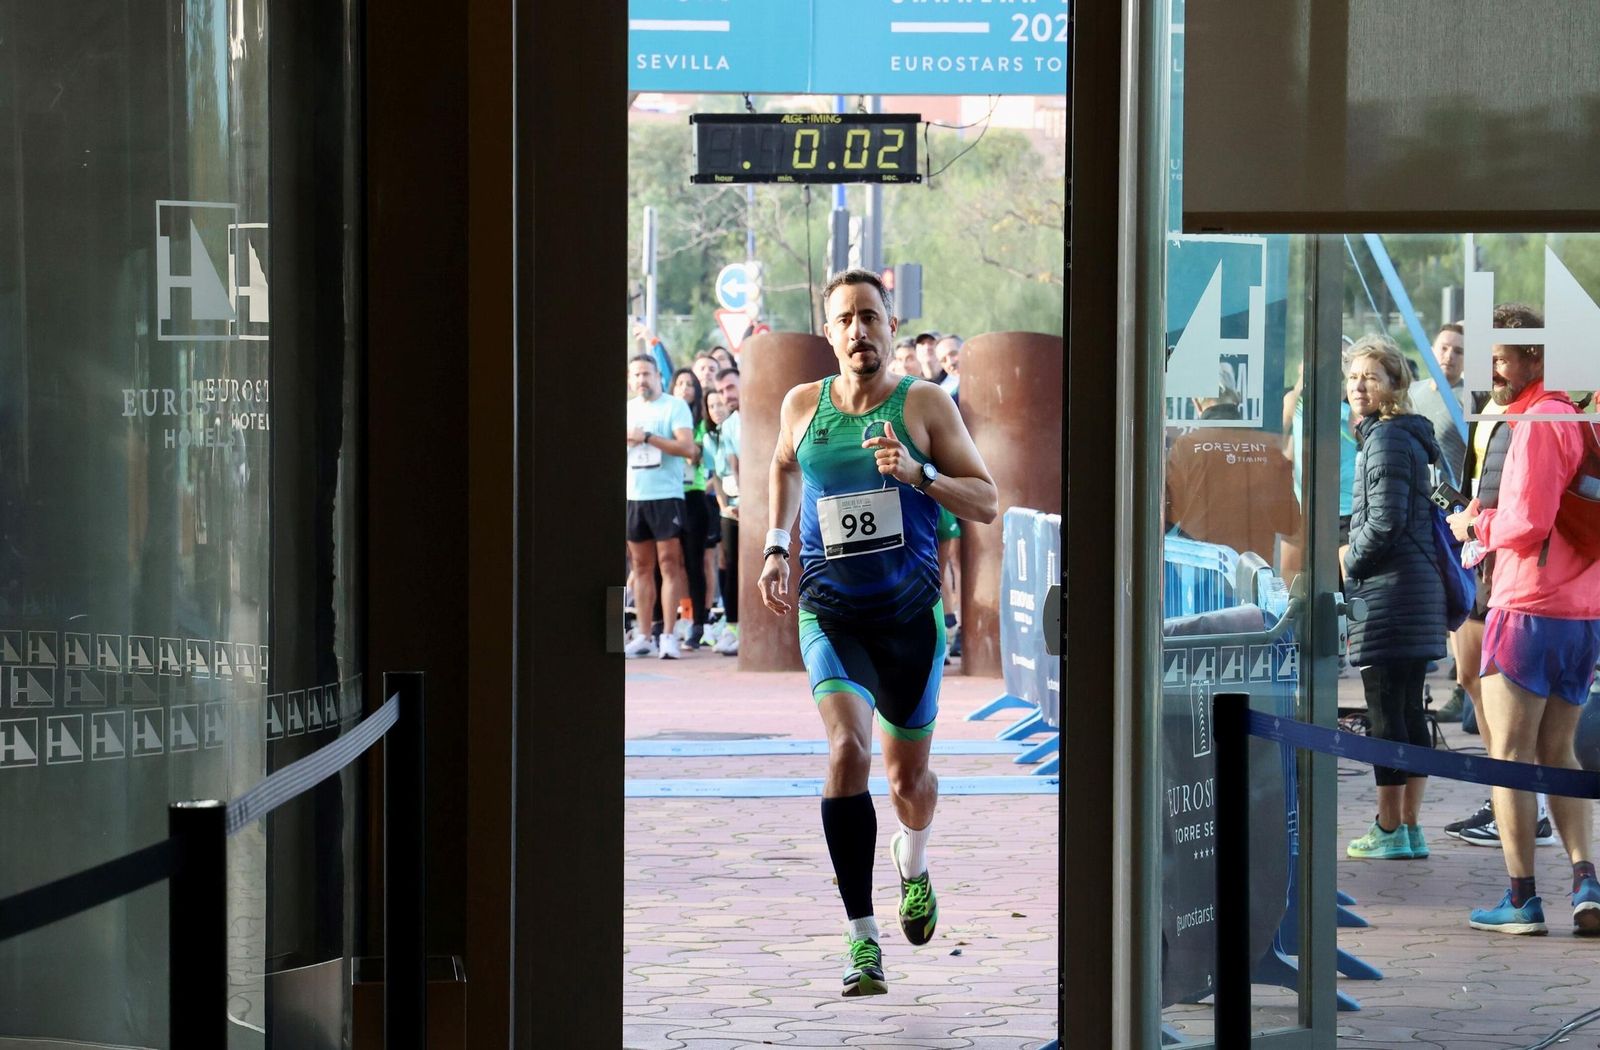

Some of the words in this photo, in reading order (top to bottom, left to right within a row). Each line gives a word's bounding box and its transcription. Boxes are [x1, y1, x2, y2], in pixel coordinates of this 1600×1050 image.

[636, 54, 730, 70] SEVILLA
[891, 56, 1024, 72] EUROSTARS
[1034, 57, 1062, 72] TO
[714, 174, 734, 182] hour
[777, 174, 795, 183] min.
[1194, 442, 1267, 454] FOREVENT
[1237, 456, 1267, 464] TIMING
[841, 511, 877, 538] 98
